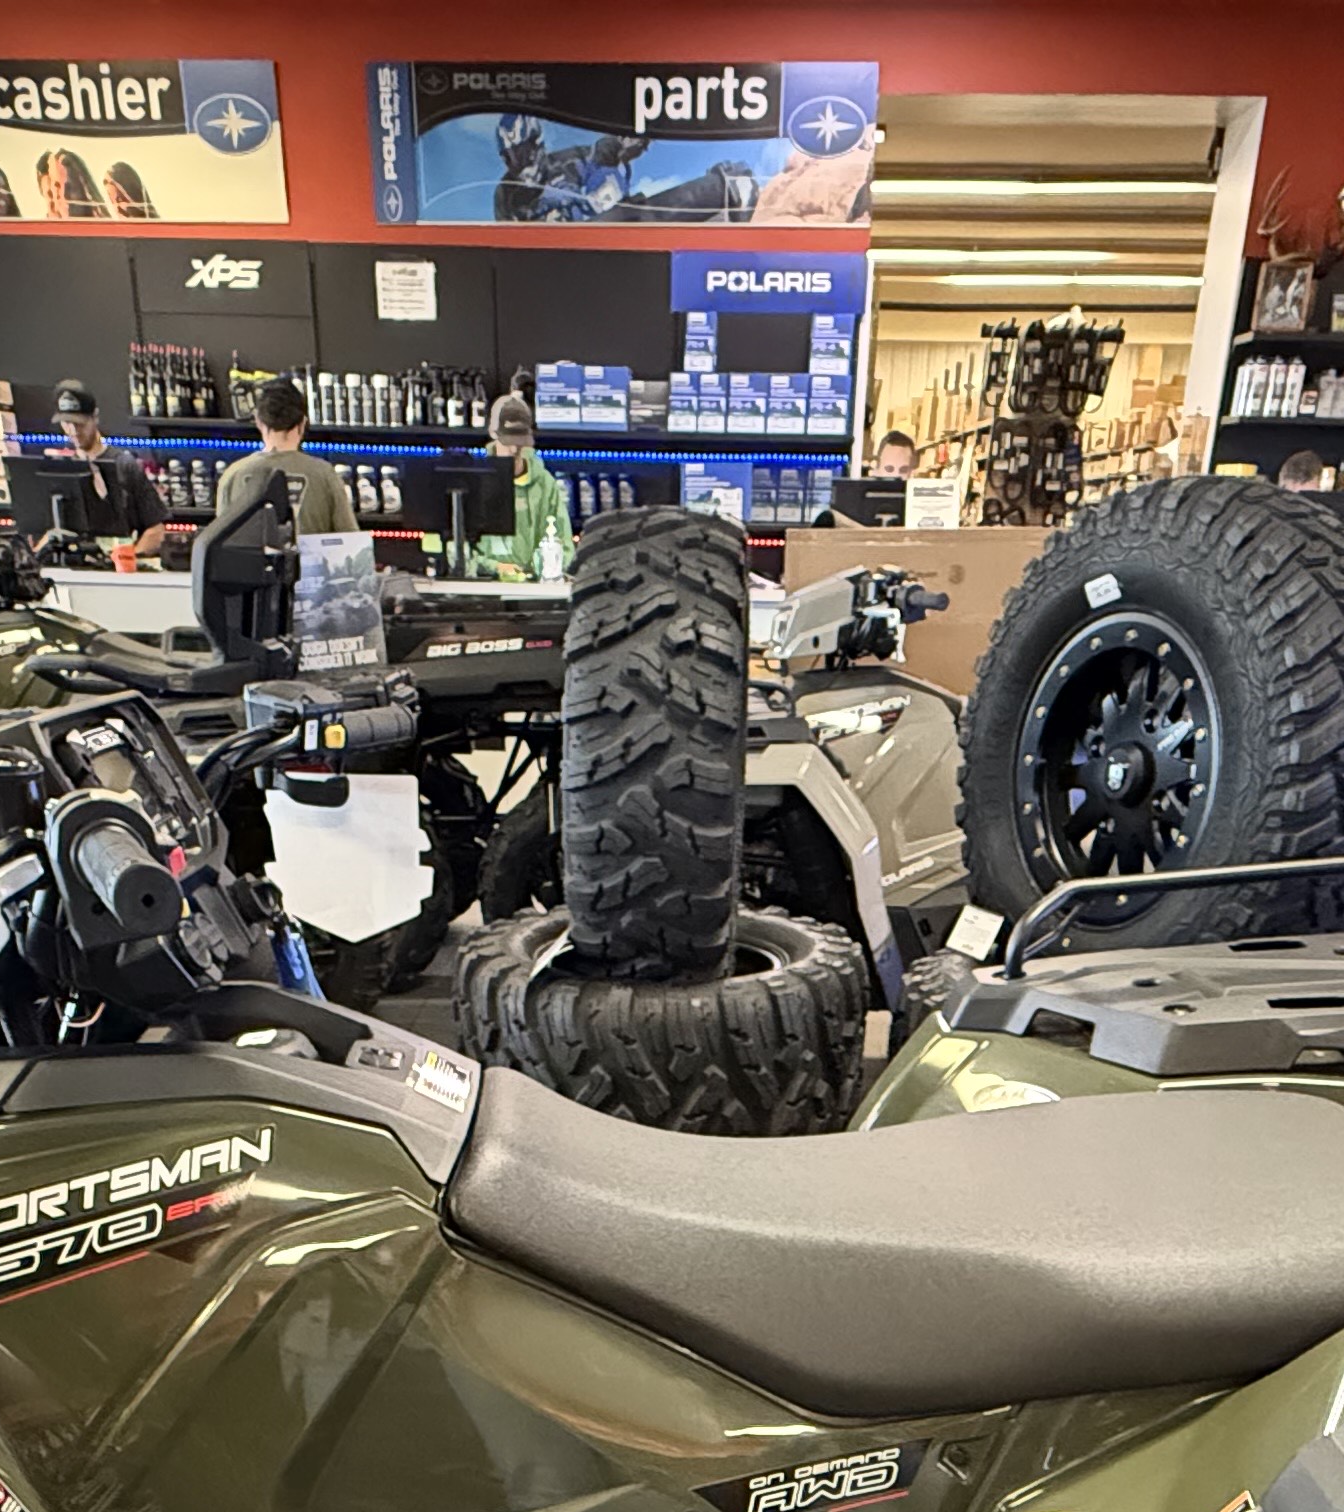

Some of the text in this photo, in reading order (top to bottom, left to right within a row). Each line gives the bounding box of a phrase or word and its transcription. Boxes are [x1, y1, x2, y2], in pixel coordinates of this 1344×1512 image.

[452, 72, 547, 90] POLARIS
[634, 67, 768, 133] parts
[378, 66, 398, 181] POLARIS
[184, 253, 264, 290] XPS
[706, 270, 832, 294] POLARIS
[426, 643, 462, 658] BIG
[465, 637, 524, 654] BOSS
[748, 1447, 901, 1490] ON DEMAND
